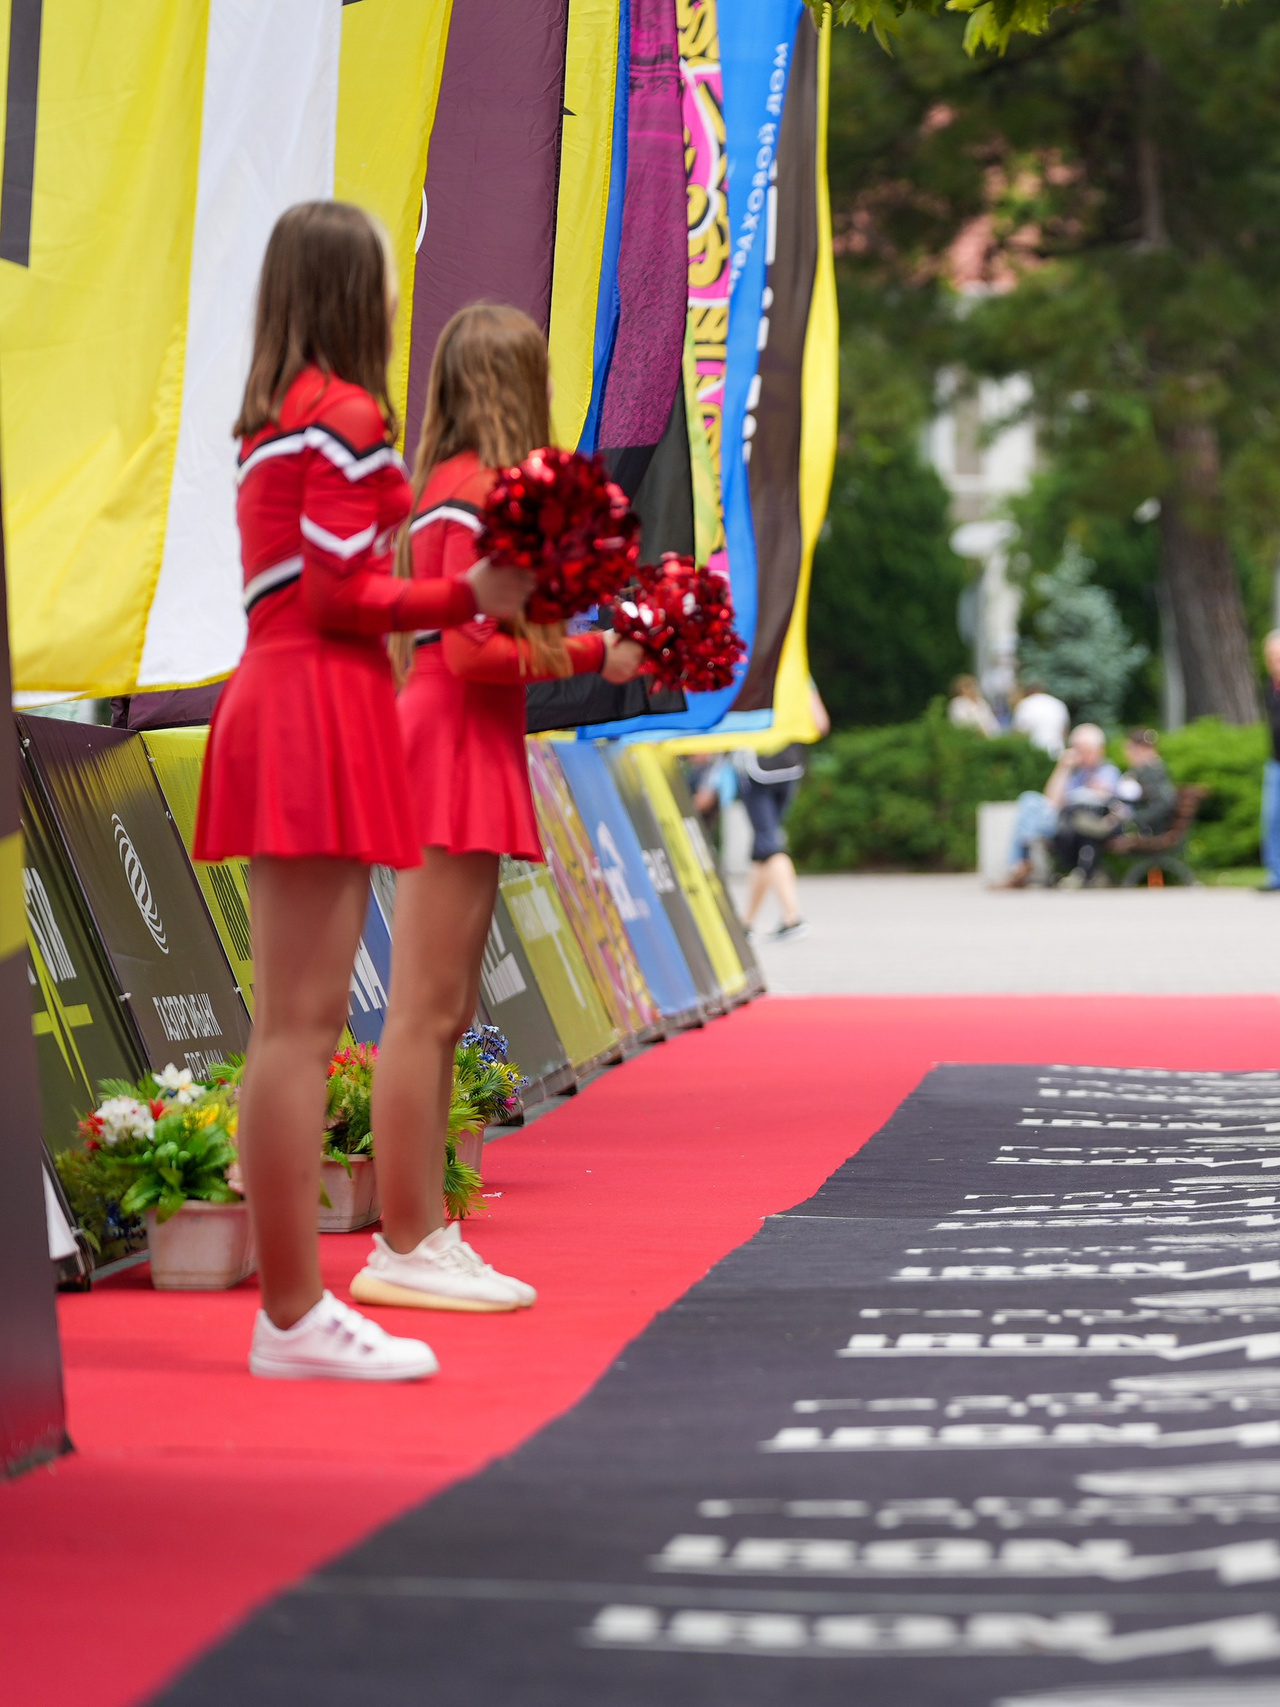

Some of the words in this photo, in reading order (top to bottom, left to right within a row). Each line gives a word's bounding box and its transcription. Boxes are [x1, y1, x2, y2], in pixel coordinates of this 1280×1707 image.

[765, 43, 788, 115] ДОМ
[206, 865, 253, 961] IRON
[1022, 1118, 1221, 1130] IRON
[993, 1156, 1214, 1166] IRON
[933, 1216, 1188, 1228] IRON
[899, 1260, 1187, 1277] IRON
[845, 1332, 1178, 1352] IRON
[770, 1422, 1160, 1450] IRON
[662, 1533, 1131, 1572] IRON
[590, 1603, 1113, 1653] IRON
